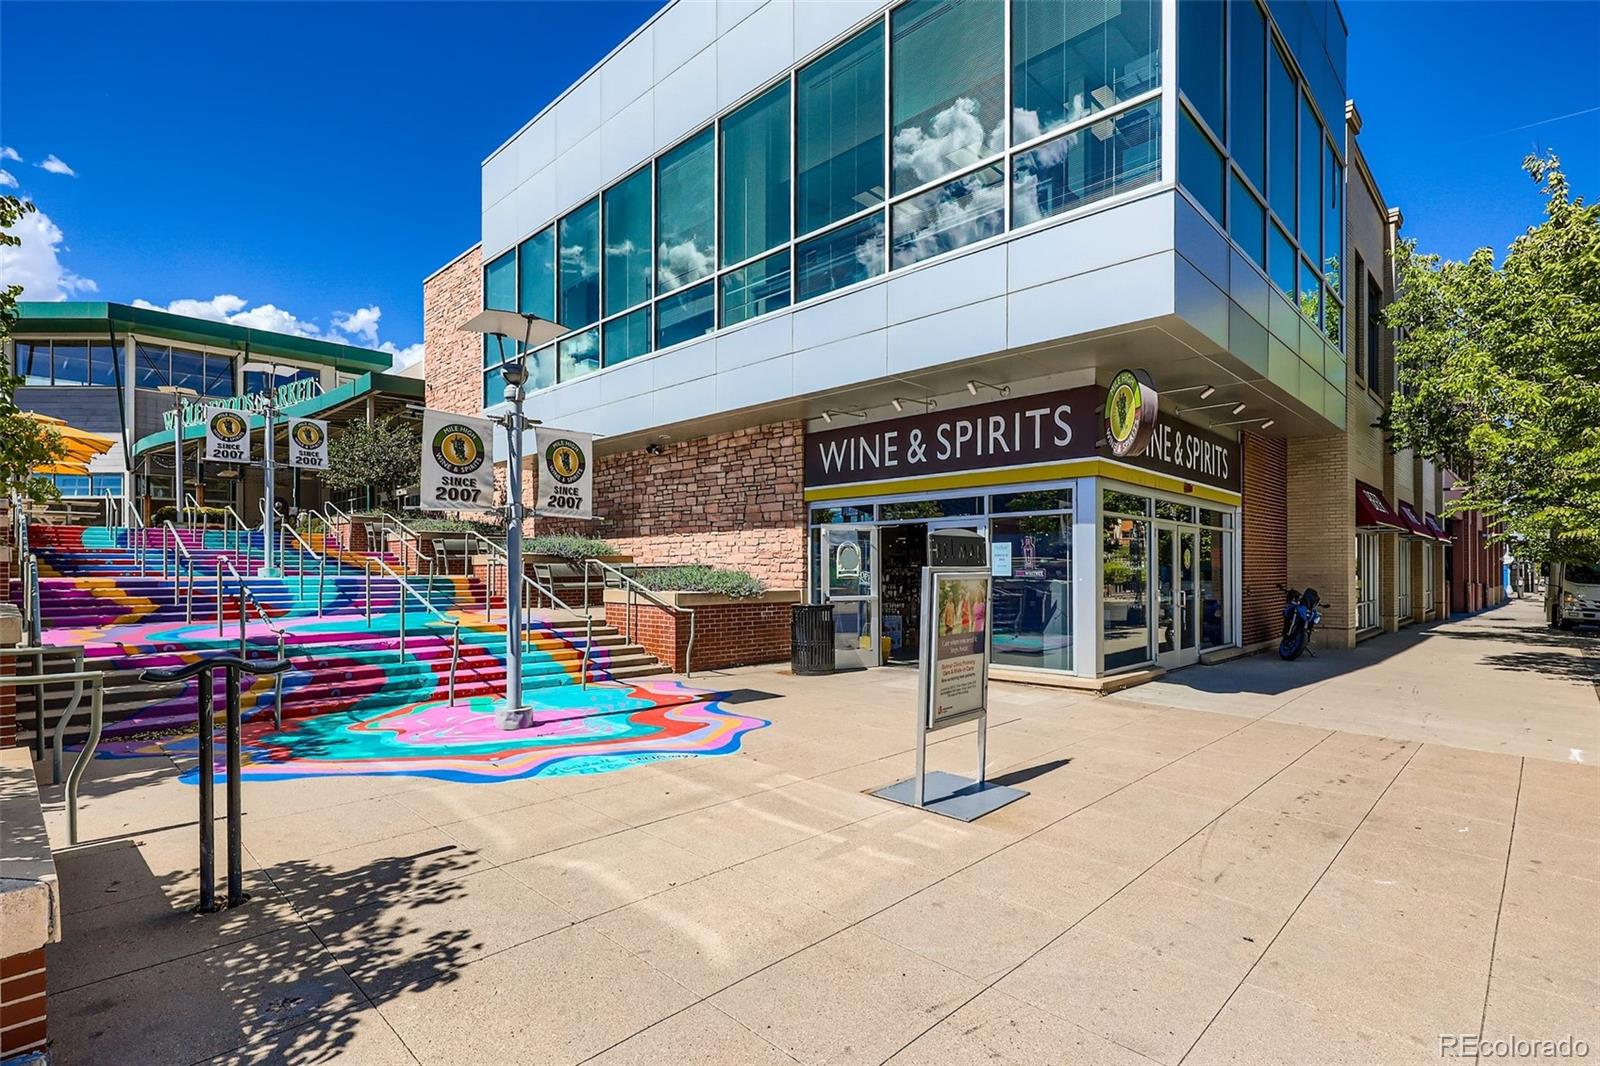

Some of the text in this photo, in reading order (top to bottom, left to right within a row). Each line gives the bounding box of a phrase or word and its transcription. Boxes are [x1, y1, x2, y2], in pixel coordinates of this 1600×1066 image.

[444, 426, 477, 440] MILE HIGH
[819, 404, 1073, 474] WINE & SPIRITS
[552, 440, 579, 452] MILE HIGH
[213, 449, 244, 459] 2007
[295, 456, 323, 466] 2007
[1174, 431, 1184, 466] &
[1186, 434, 1228, 480] SPIRITS
[436, 452, 451, 471] WINE
[460, 457, 482, 473] SPIRITS
[549, 464, 561, 482] WINE
[567, 468, 584, 483] SPIRITS
[442, 476, 477, 488] SINCE
[436, 486, 482, 502] 2007
[553, 486, 579, 496] SINCE
[548, 495, 583, 509] 2007
